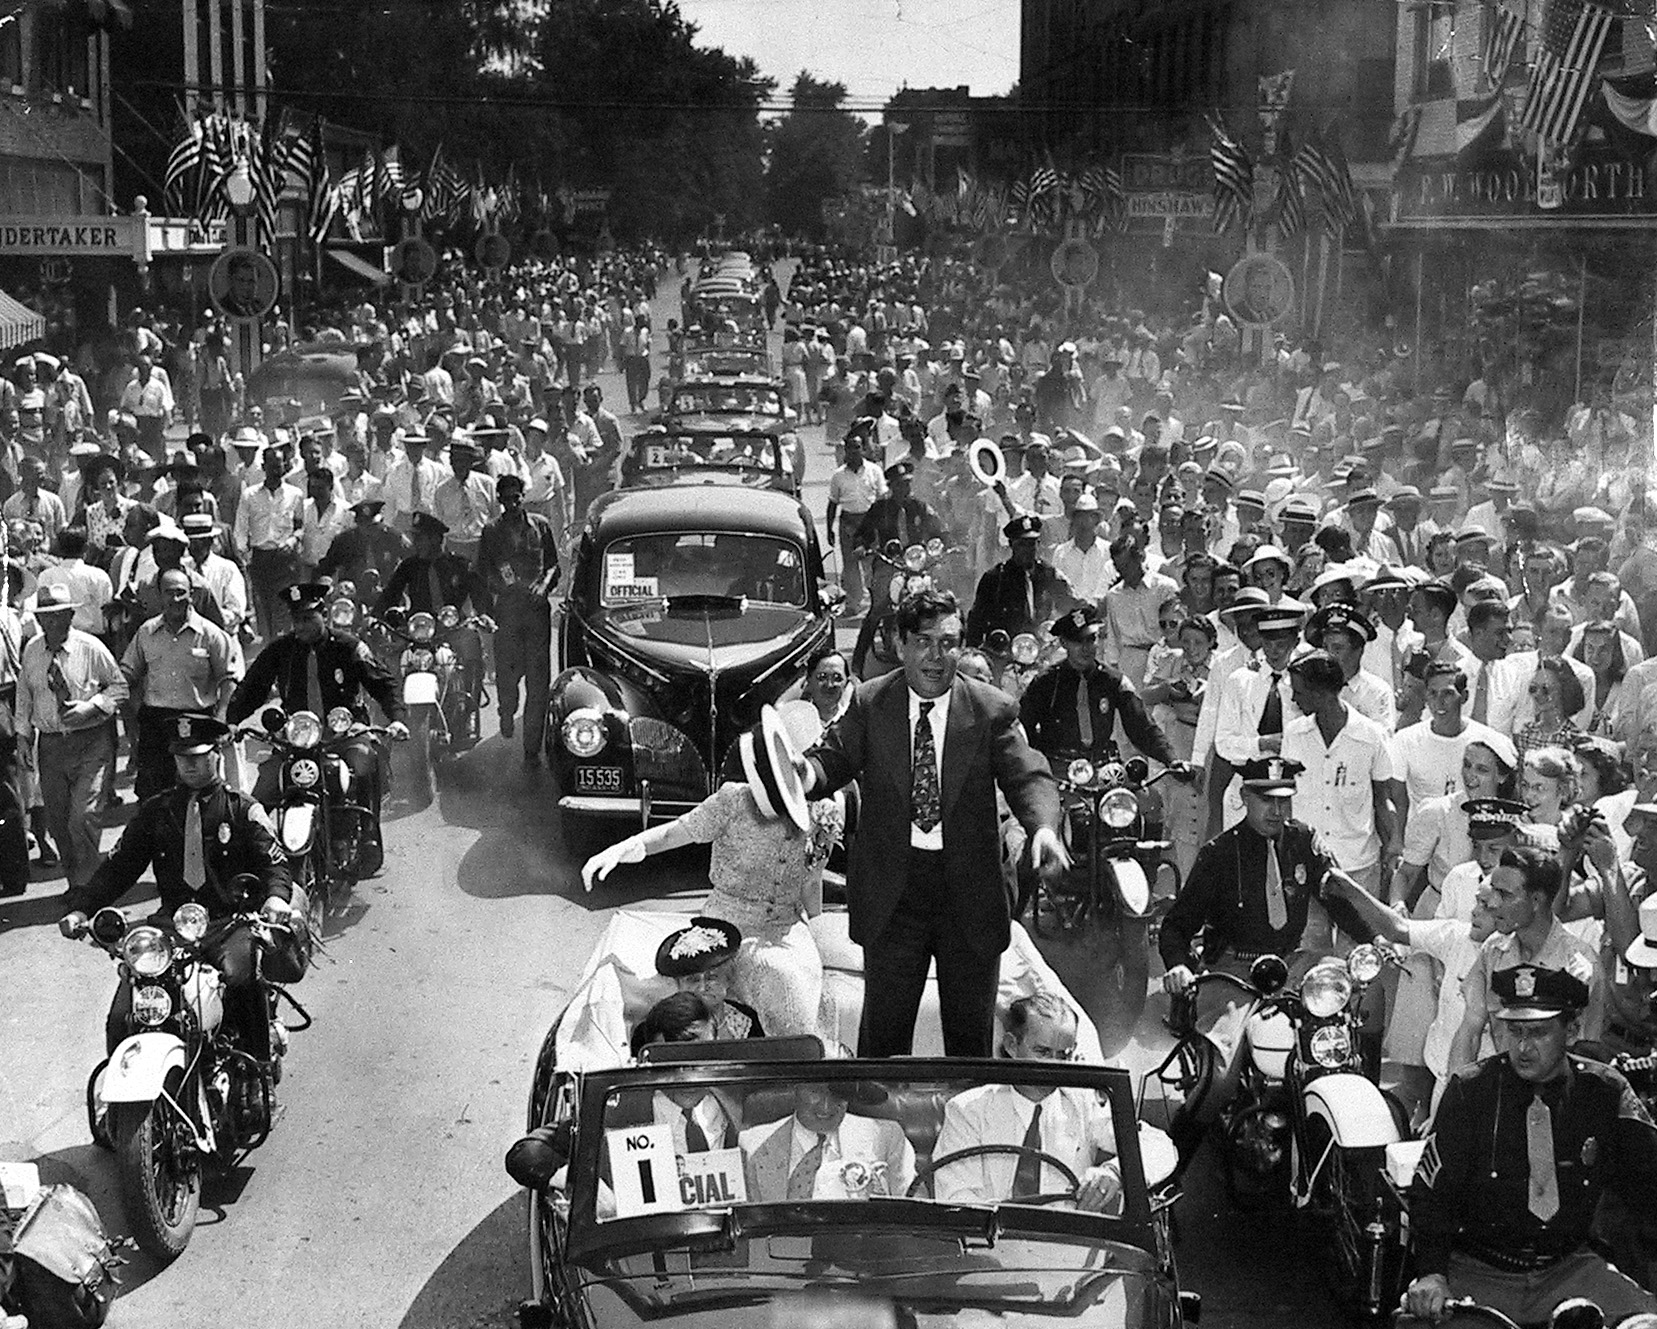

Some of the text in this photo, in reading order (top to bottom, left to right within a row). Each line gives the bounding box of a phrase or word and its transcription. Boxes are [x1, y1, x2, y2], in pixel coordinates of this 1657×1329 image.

[1468, 162, 1643, 202] WOOLORTH
[0, 226, 117, 246] DERTAKER
[652, 452, 660, 464] 2
[610, 585, 653, 596] OFFICIAL
[626, 1134, 655, 1151] NO.
[637, 1159, 657, 1204] 1
